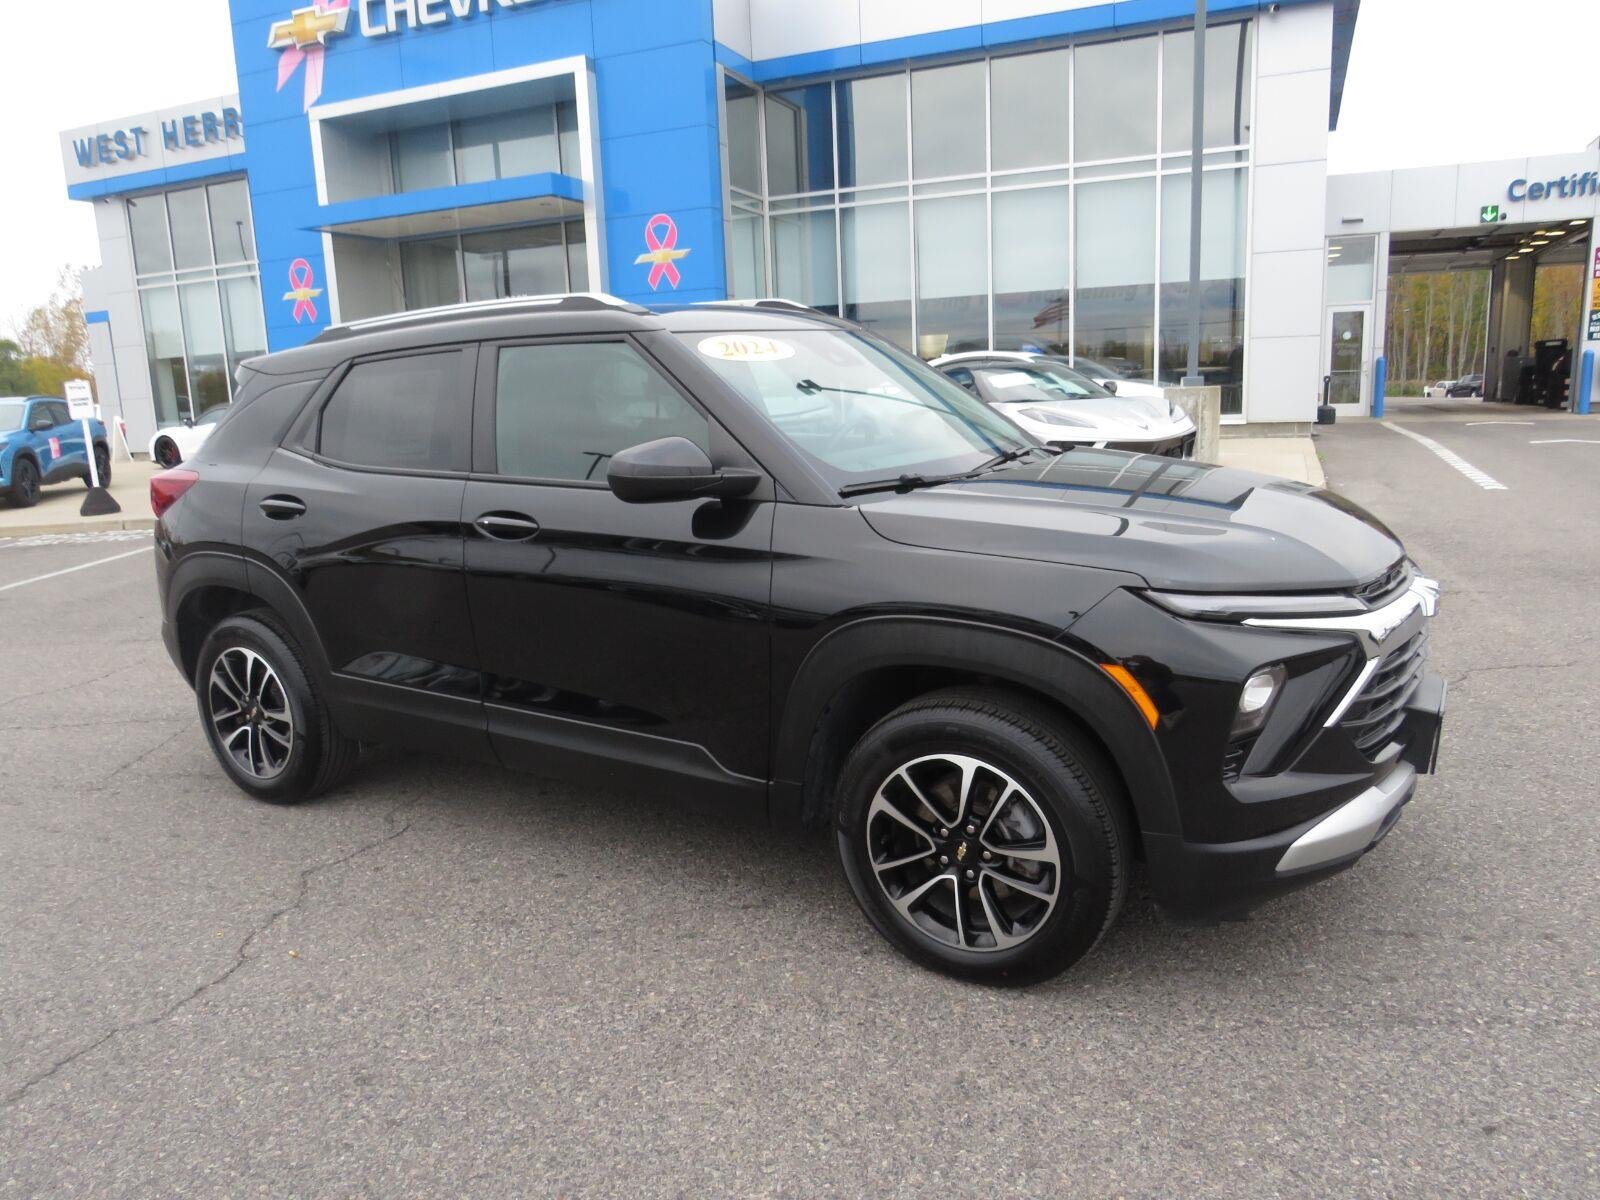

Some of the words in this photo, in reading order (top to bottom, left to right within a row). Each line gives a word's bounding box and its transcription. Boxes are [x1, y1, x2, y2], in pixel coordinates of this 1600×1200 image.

[358, 0, 534, 37] CHE
[73, 126, 148, 168] WEST
[161, 107, 241, 152] HERR
[1508, 171, 1600, 202] Certifi
